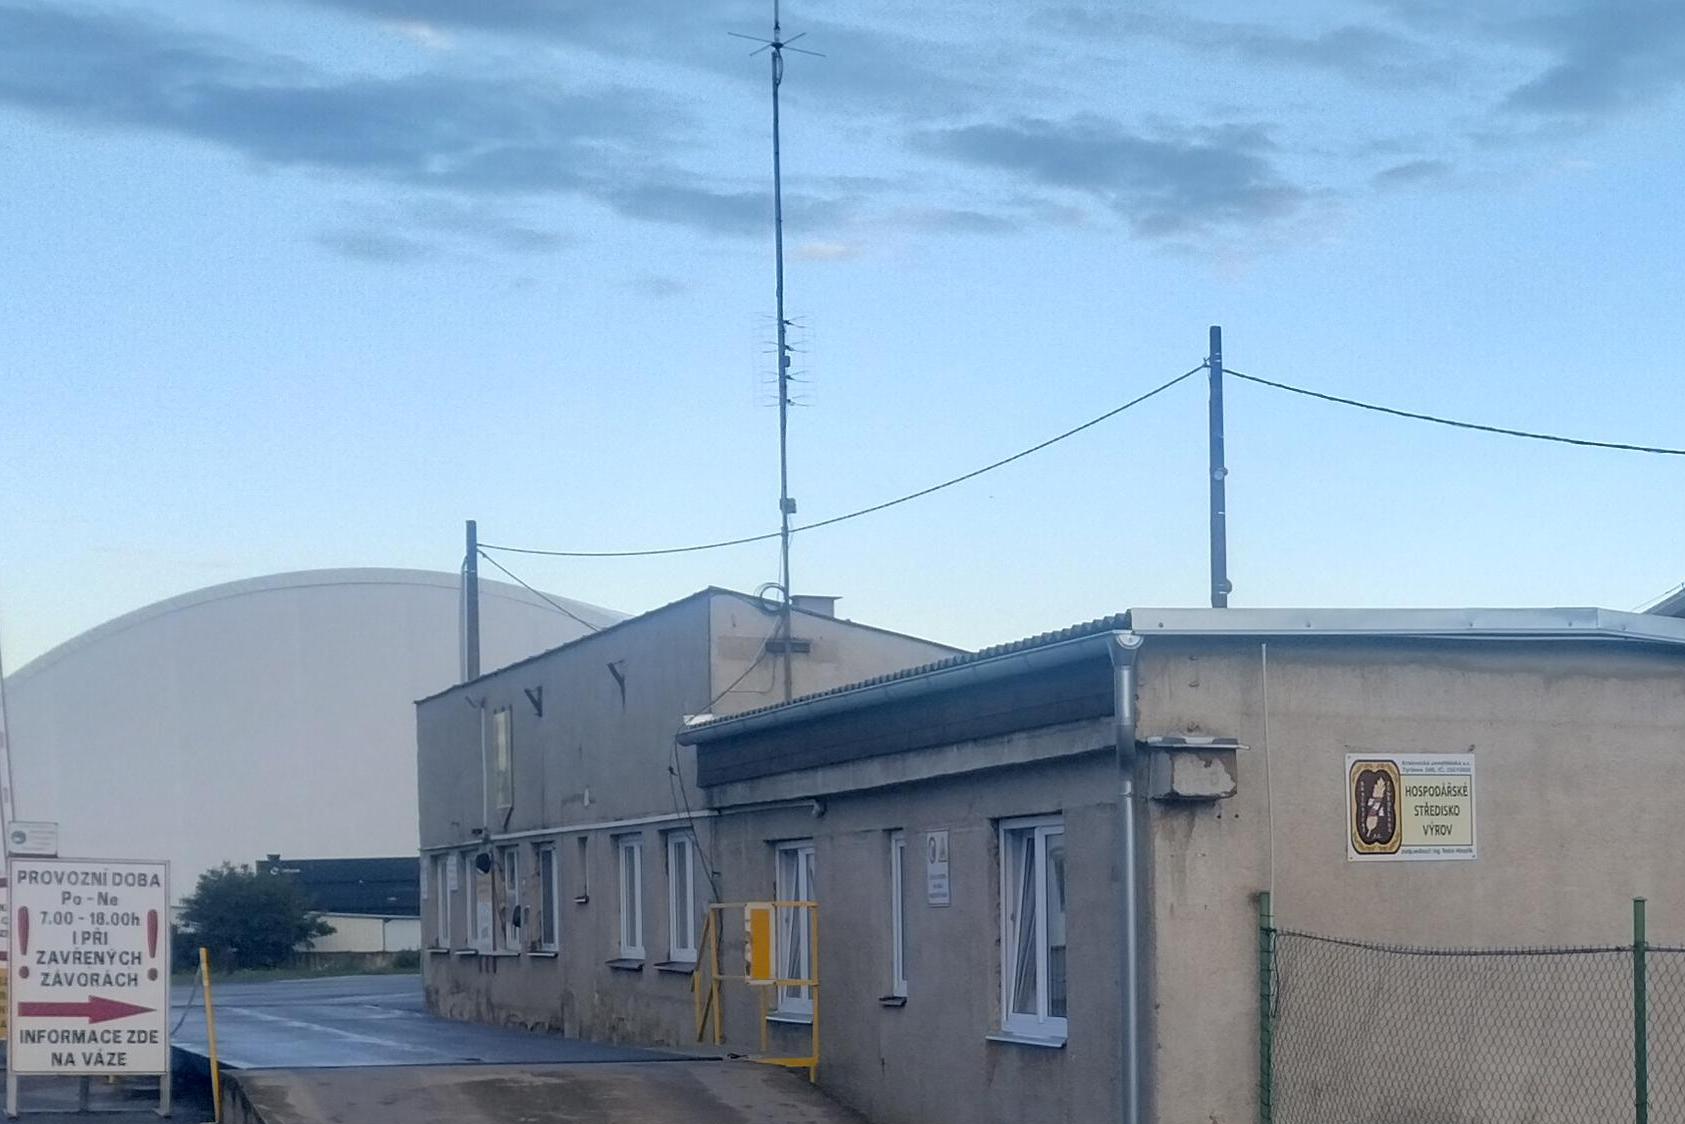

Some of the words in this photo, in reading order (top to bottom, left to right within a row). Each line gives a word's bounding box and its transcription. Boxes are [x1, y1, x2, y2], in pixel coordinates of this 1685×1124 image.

[1405, 782, 1468, 797] HOSPODÁŘSKÉ
[1414, 803, 1460, 817] STŘEDISKO
[1423, 822, 1452, 836] VÝROV
[17, 868, 108, 886] PROVOZNÍ
[112, 872, 161, 888] DOBA
[61, 891, 82, 906] Po
[97, 892, 118, 906] Ne
[40, 912, 73, 925] 7.00
[90, 912, 140, 926] 18.00h
[72, 932, 76, 945] I
[81, 928, 108, 946] PŘI
[20, 1030, 121, 1044] INFORMACE
[127, 1030, 159, 1044] ZDE
[51, 1053, 75, 1066] NA
[83, 1049, 127, 1067] VÁZE
